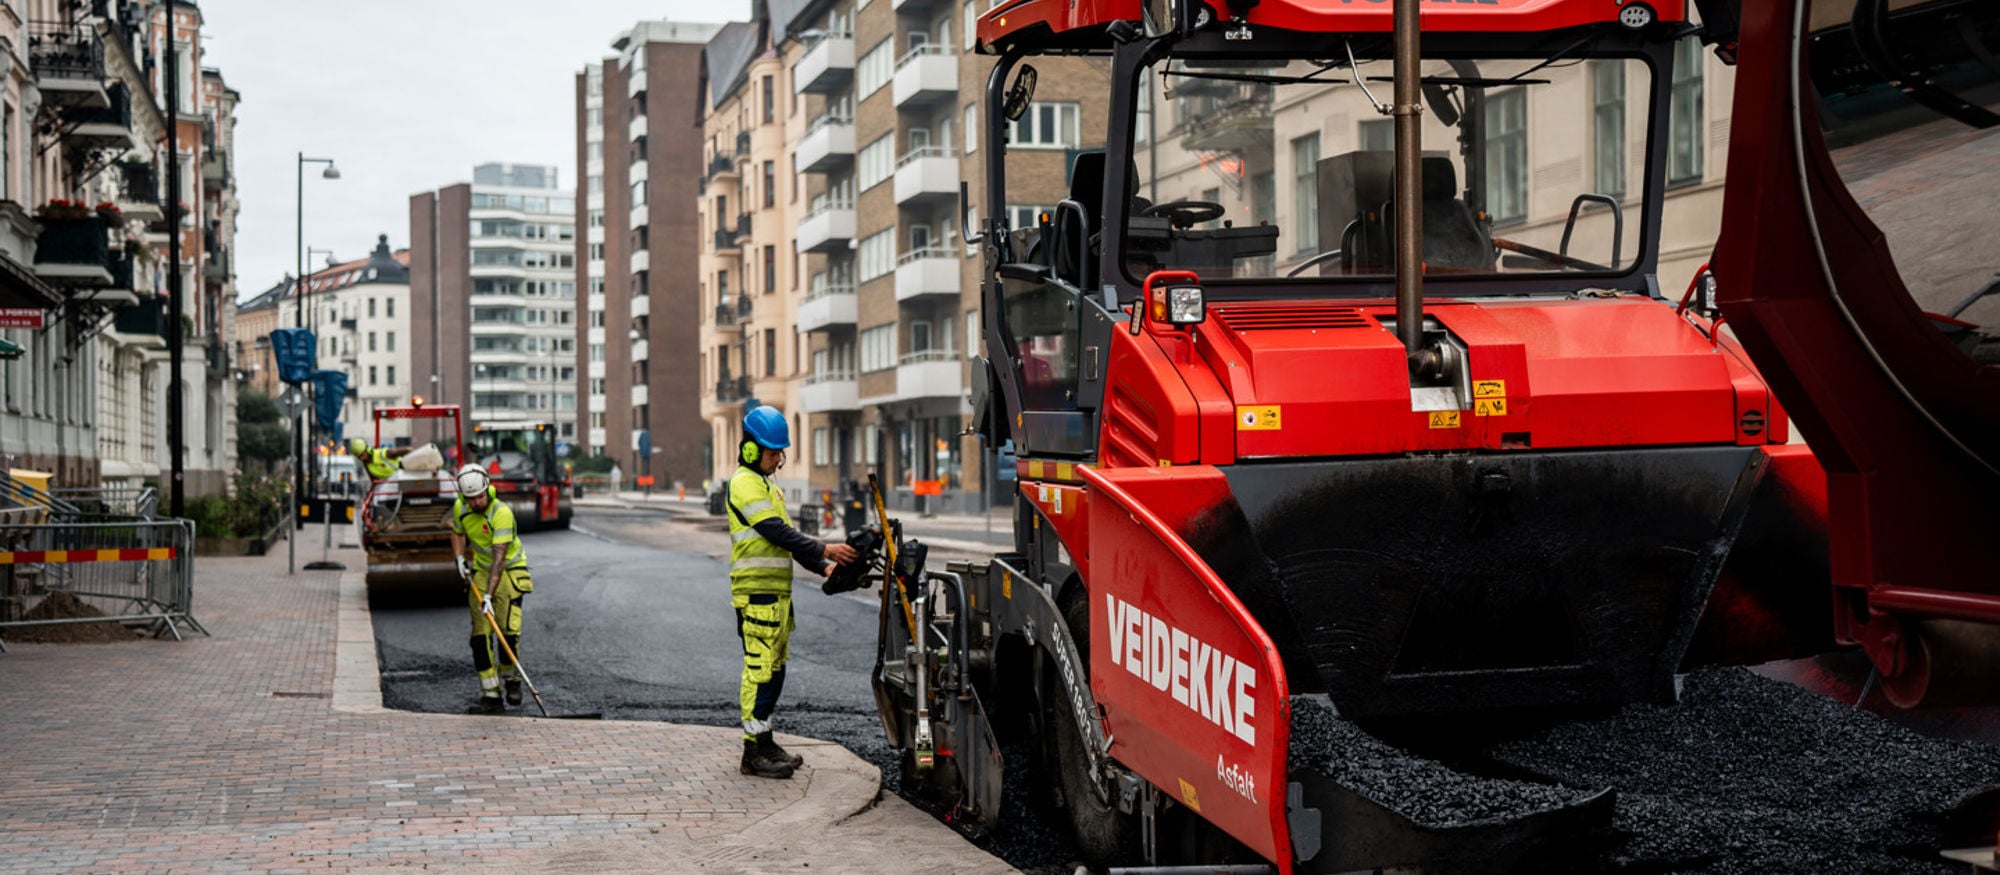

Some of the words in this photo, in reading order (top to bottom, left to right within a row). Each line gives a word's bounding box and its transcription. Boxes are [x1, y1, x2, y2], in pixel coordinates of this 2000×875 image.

[1052, 622, 1075, 692] SUPER
[1106, 593, 1256, 747] VEIDEKKE
[1217, 754, 1257, 804] Asfalt
